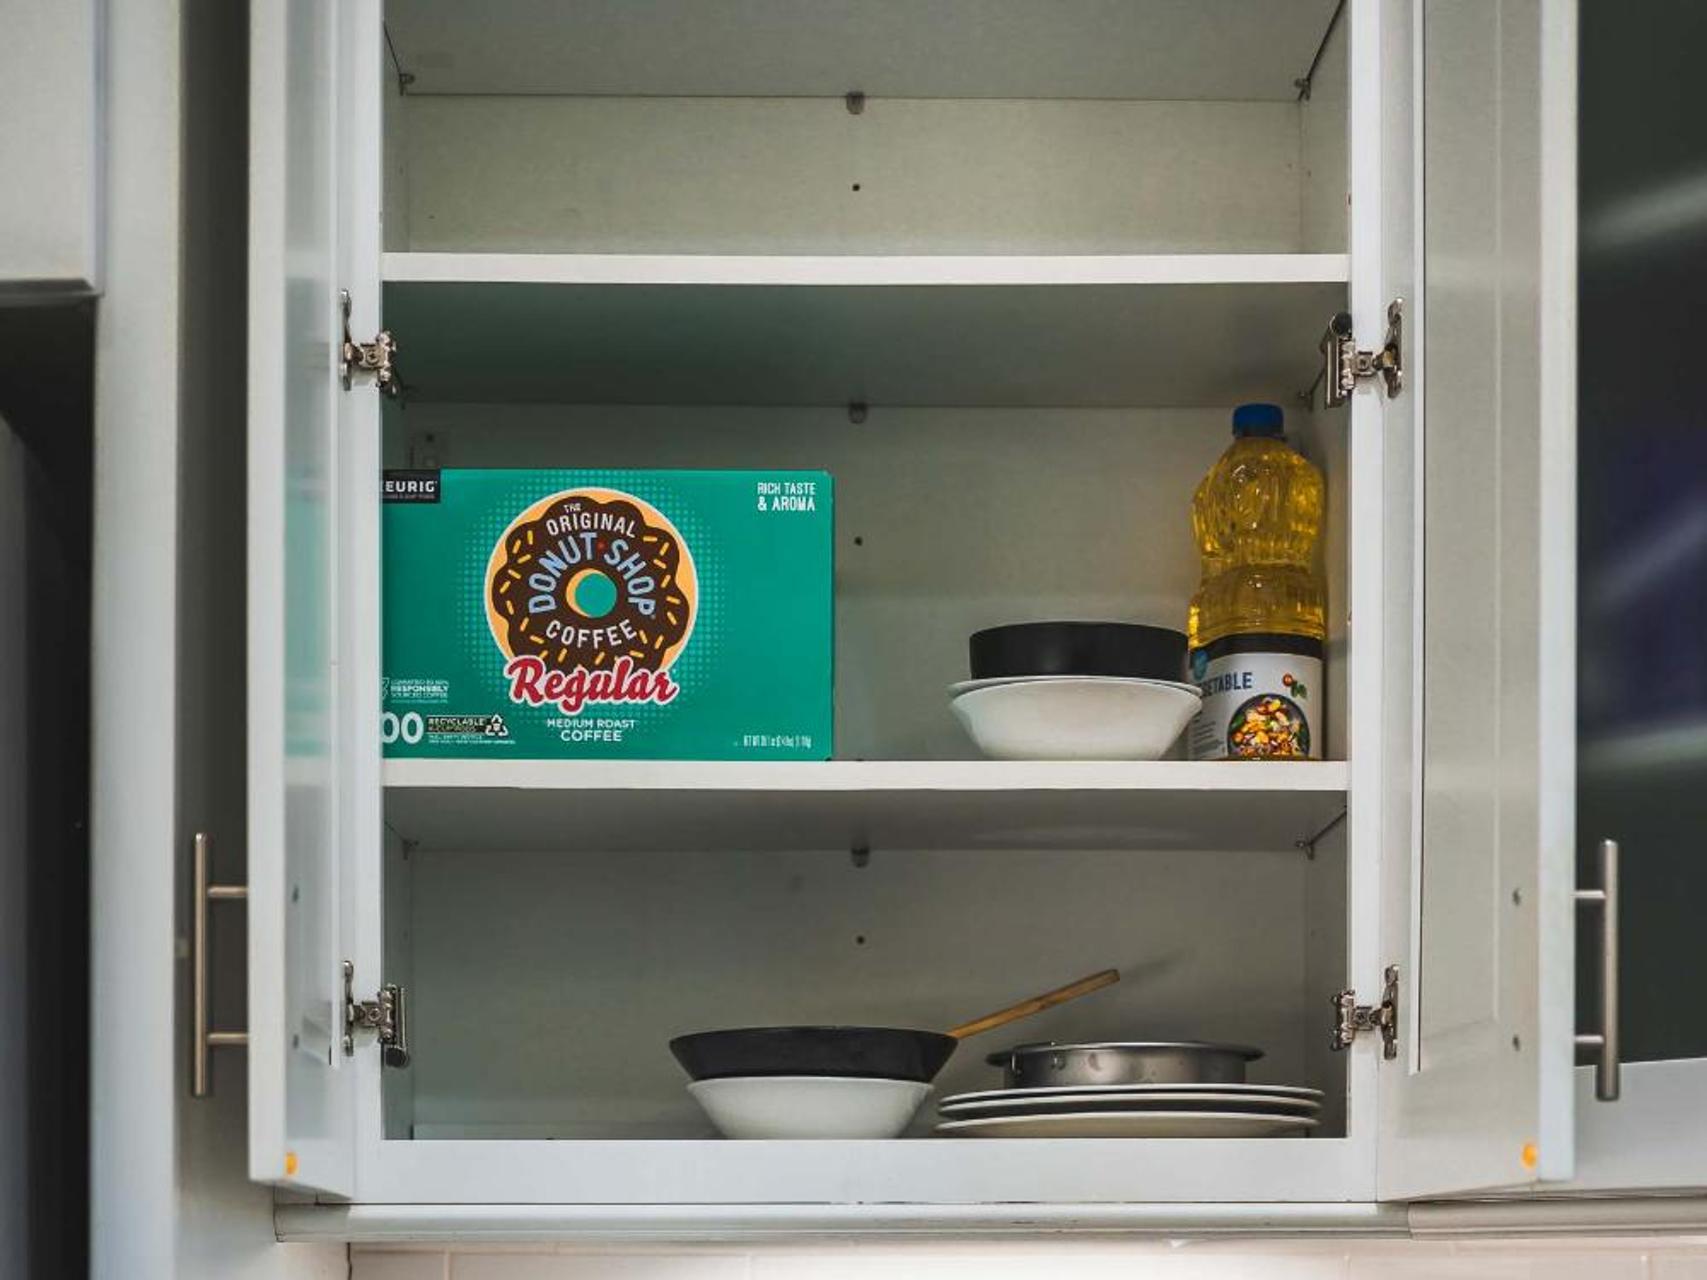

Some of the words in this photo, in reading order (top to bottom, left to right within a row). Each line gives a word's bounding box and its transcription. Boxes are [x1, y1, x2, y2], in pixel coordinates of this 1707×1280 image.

[384, 480, 435, 492] EURIG
[757, 482, 781, 495] RICH
[784, 482, 816, 495] TASTE
[564, 503, 581, 513] THE
[757, 496, 768, 511] &
[772, 496, 816, 511] AROMA
[546, 513, 637, 538] ORIGINAL
[529, 532, 597, 614] DONUT
[604, 539, 656, 616] SHOP
[546, 619, 637, 650] COFFEE
[505, 656, 678, 714] Regular
[547, 719, 593, 728] MEDIUM
[597, 719, 635, 728] ROAST
[560, 730, 622, 741] COFFEE
